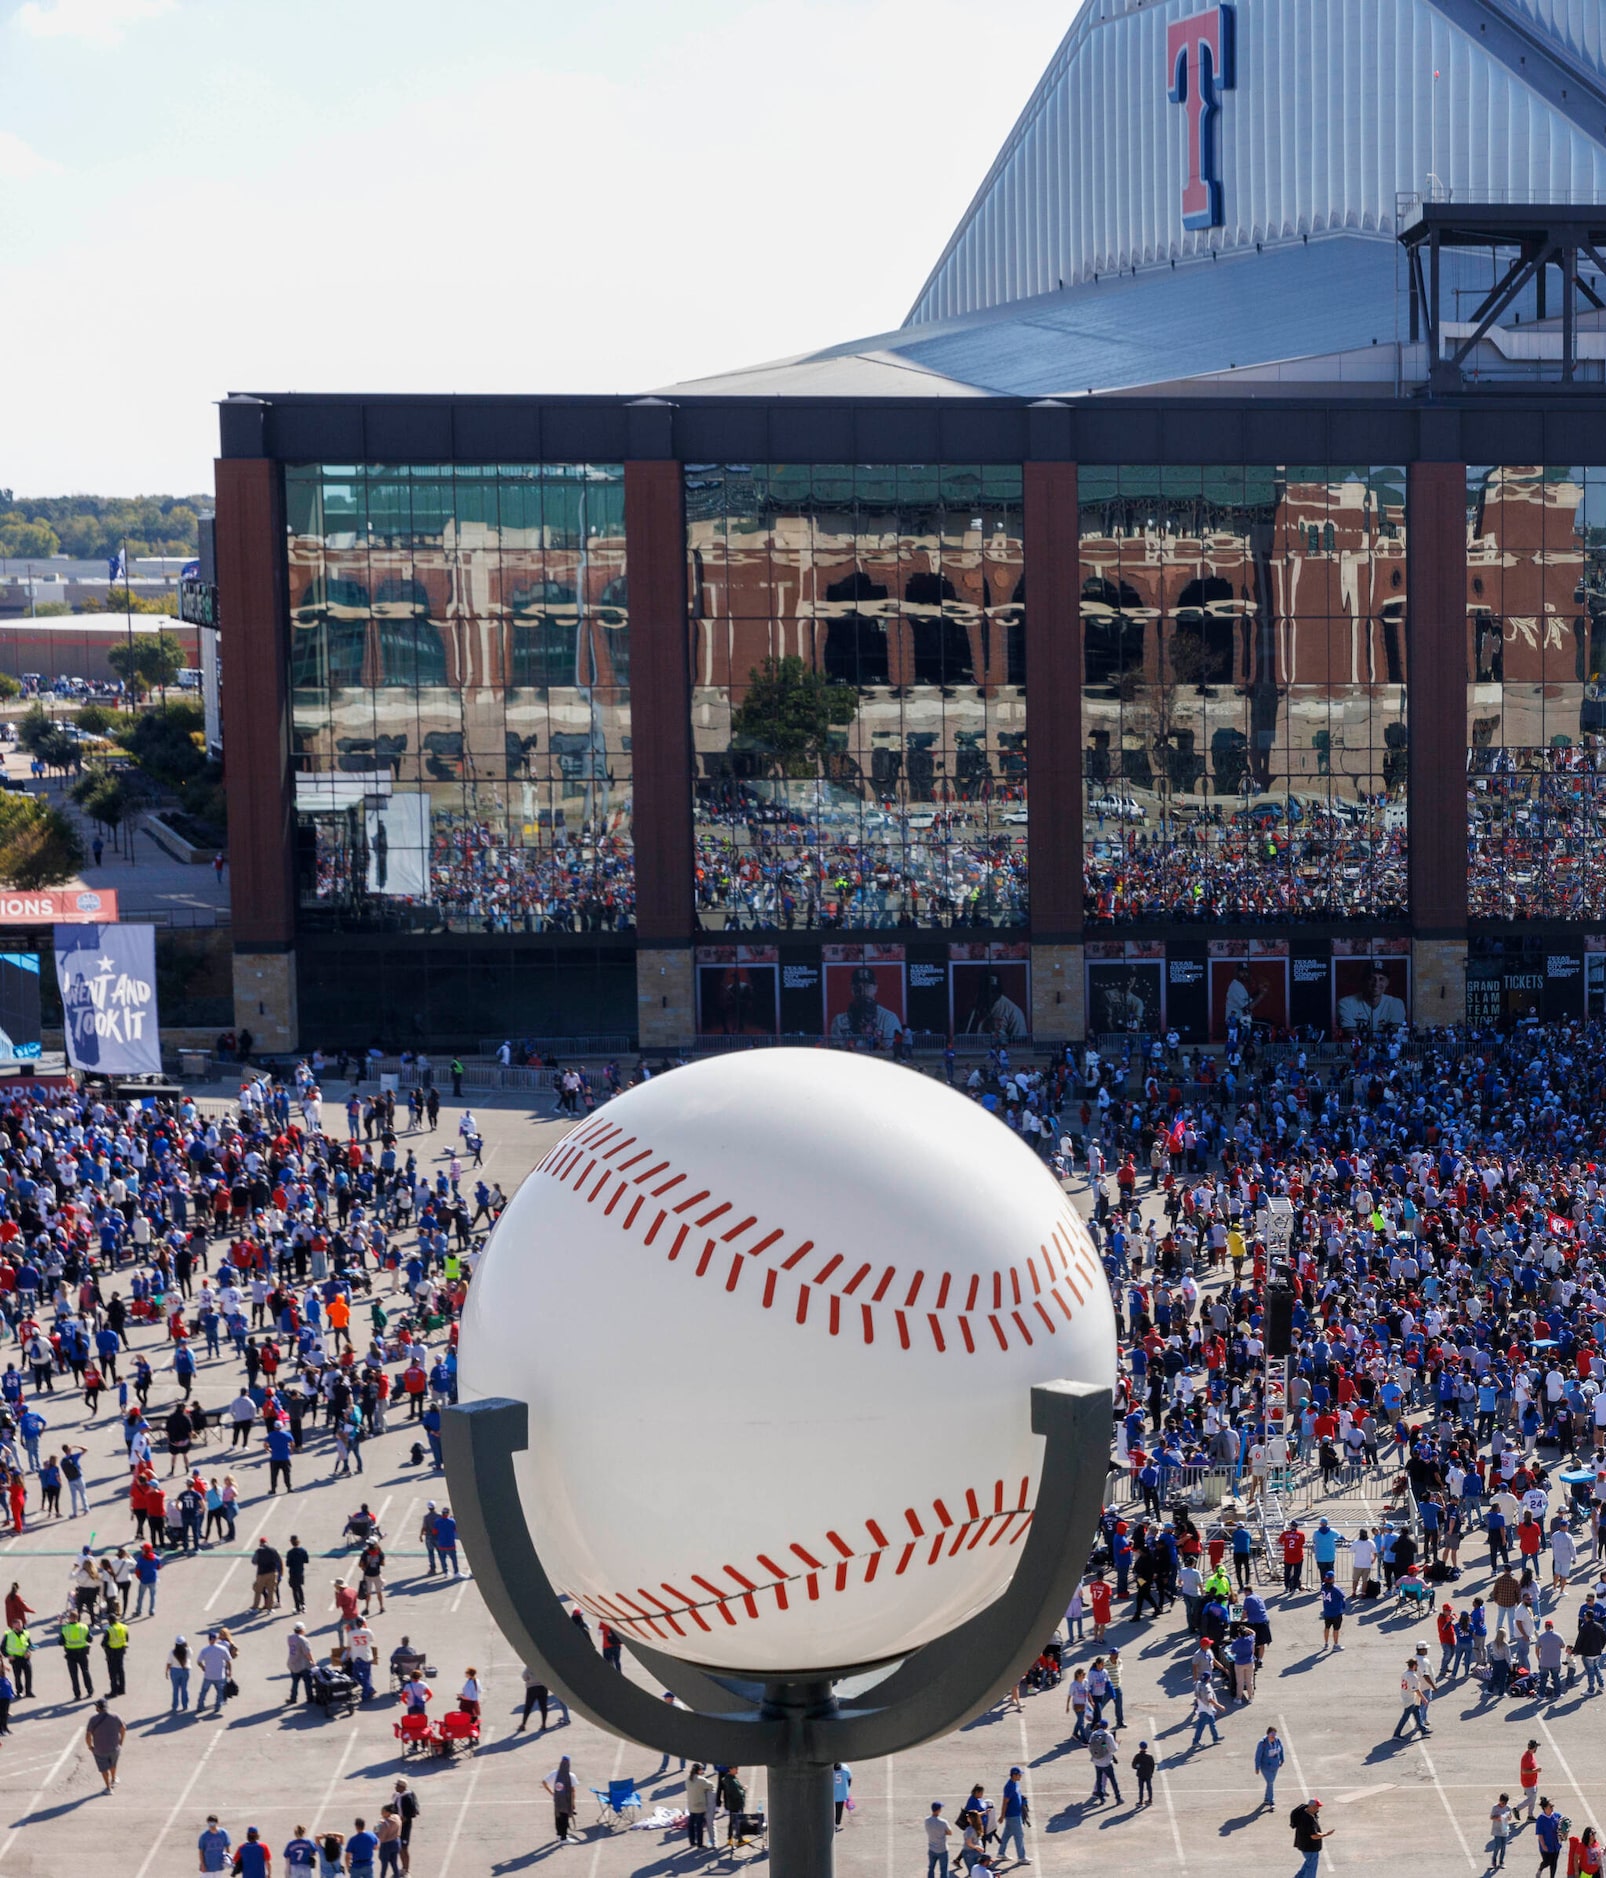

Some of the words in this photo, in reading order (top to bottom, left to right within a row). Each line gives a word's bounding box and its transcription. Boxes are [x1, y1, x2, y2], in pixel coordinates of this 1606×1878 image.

[1167, 4, 1234, 231] T
[63, 972, 71, 993] I
[1467, 980, 1500, 991] GRAND
[1504, 974, 1543, 990] TICKETS
[66, 973, 116, 1010] WENT
[111, 973, 151, 1007] AND
[1467, 992, 1500, 1003] SLAM
[1467, 1005, 1500, 1015] TEAM
[73, 1006, 124, 1044] TOOK
[124, 1007, 146, 1041] IT
[1255, 1451, 1260, 1459] 6
[1531, 1500, 1542, 1508] 24
[1289, 1540, 1295, 1548] 2
[1093, 1591, 1103, 1599] 17
[836, 1774, 842, 1783] 5
[296, 1850, 303, 1861] 7
